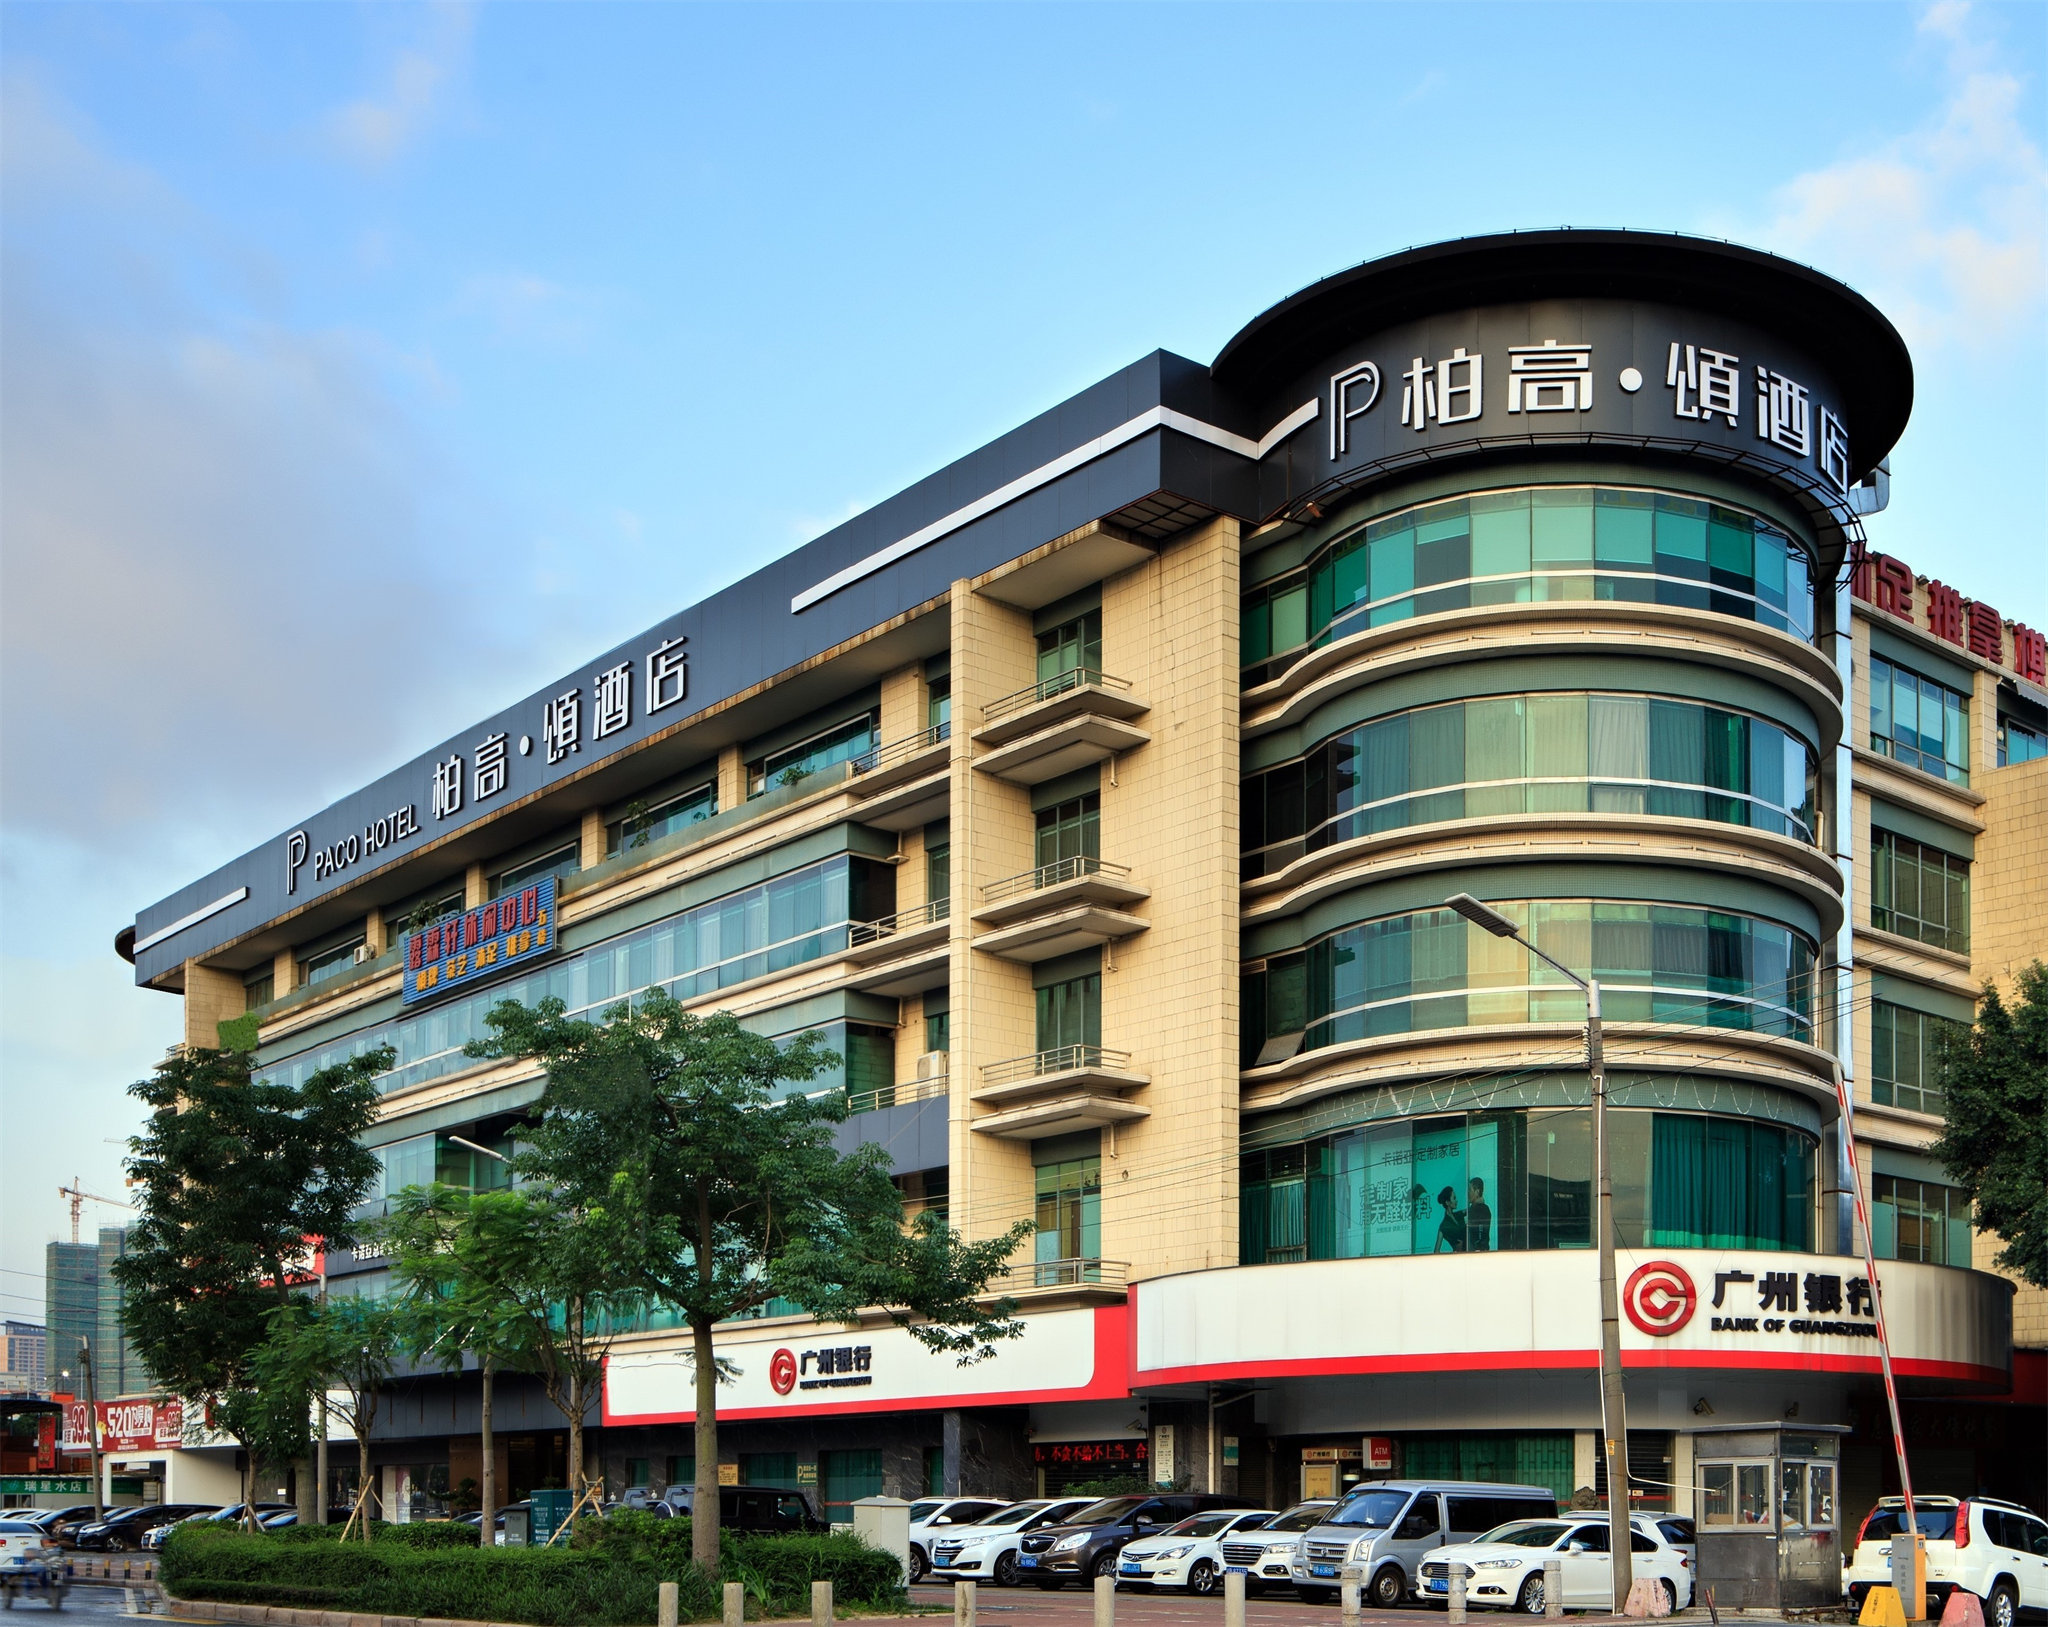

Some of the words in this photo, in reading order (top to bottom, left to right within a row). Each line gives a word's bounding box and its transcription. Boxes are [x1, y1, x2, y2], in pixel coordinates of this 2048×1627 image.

[314, 834, 358, 881] PACO
[364, 804, 419, 856] HOTEL
[1712, 1270, 1881, 1317] 广州银行
[1711, 1317, 1759, 1332] BANK
[1763, 1318, 1786, 1333] OF
[800, 1345, 872, 1375] 广州银行
[1374, 1447, 1388, 1455] ATM
[24, 1480, 82, 1492] 瑞星水店
